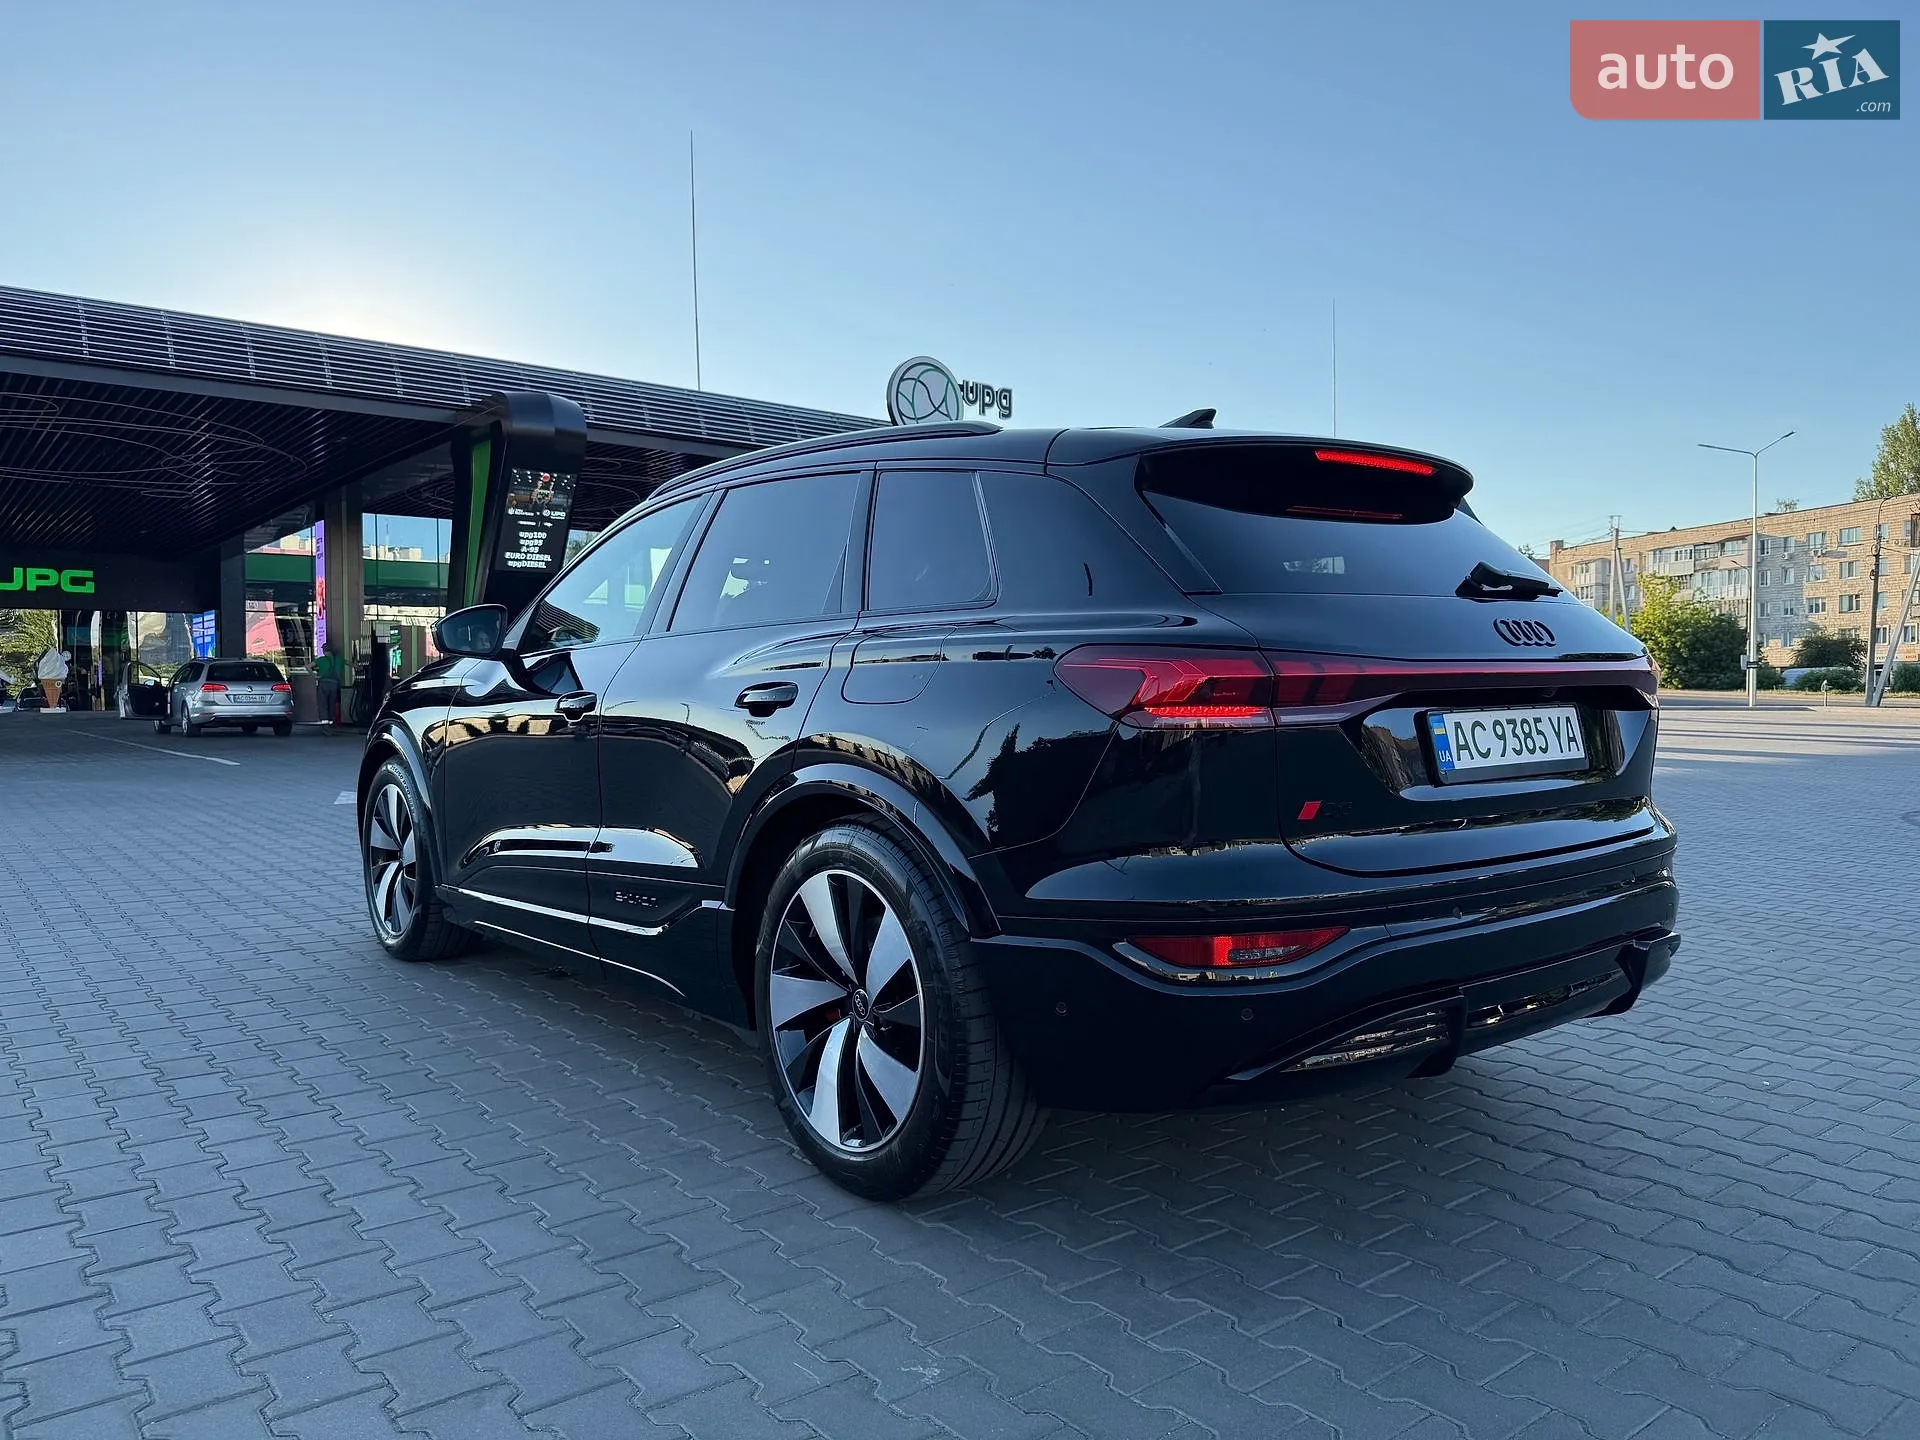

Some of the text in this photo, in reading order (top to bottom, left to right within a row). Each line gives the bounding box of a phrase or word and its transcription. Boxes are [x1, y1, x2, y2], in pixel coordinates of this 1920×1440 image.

[962, 379, 1013, 420] upg
[505, 552, 552, 561] EURO DIESEL
[1453, 715, 1580, 761] AC 9385 YA
[1438, 750, 1453, 762] UA
